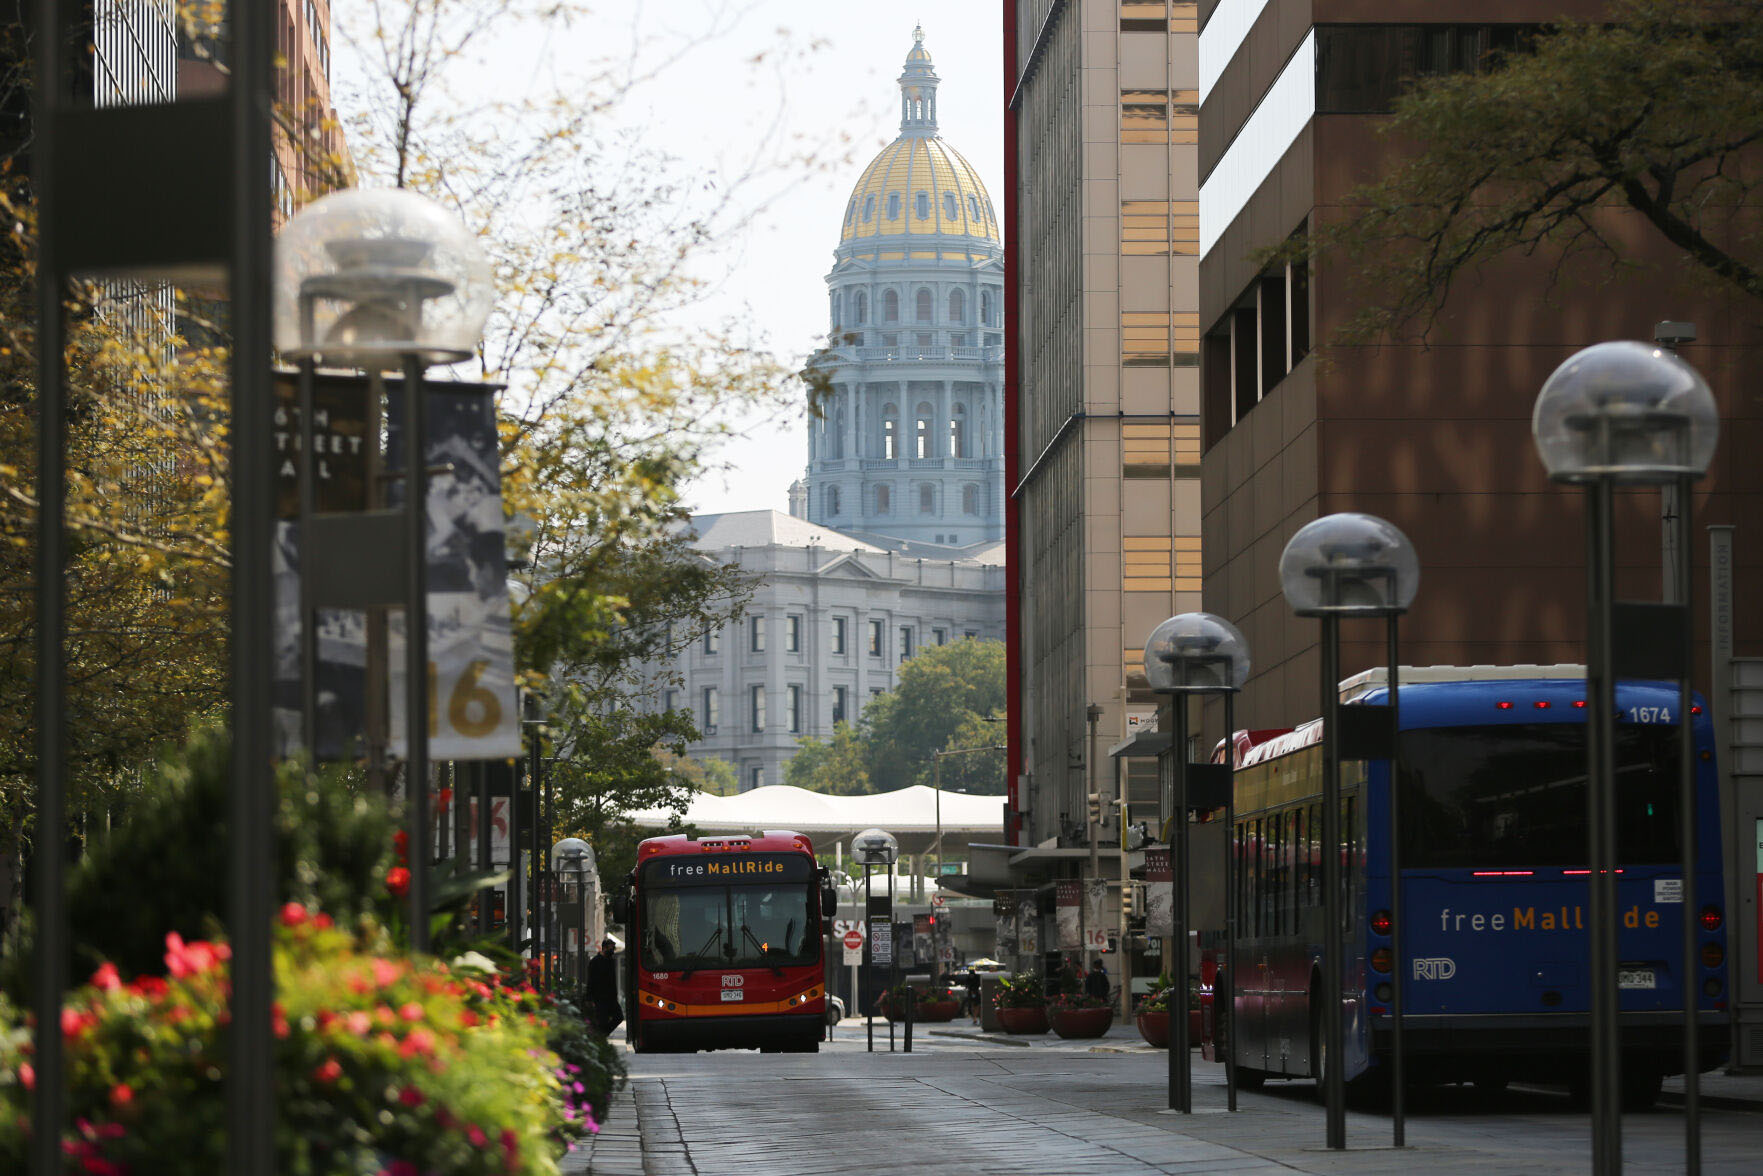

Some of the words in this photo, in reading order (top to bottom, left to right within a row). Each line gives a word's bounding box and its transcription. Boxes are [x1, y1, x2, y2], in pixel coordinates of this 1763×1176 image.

[274, 432, 362, 454] TEET
[1718, 544, 1729, 650] INFORMATION
[1630, 707, 1671, 723] 1674
[670, 864, 703, 876] free
[707, 861, 784, 875] MallRide
[1440, 908, 1505, 931] free
[1513, 905, 1661, 930] Mallde
[1086, 929, 1106, 945] 16
[1412, 957, 1457, 982] RTD
[722, 975, 744, 987] RTD
